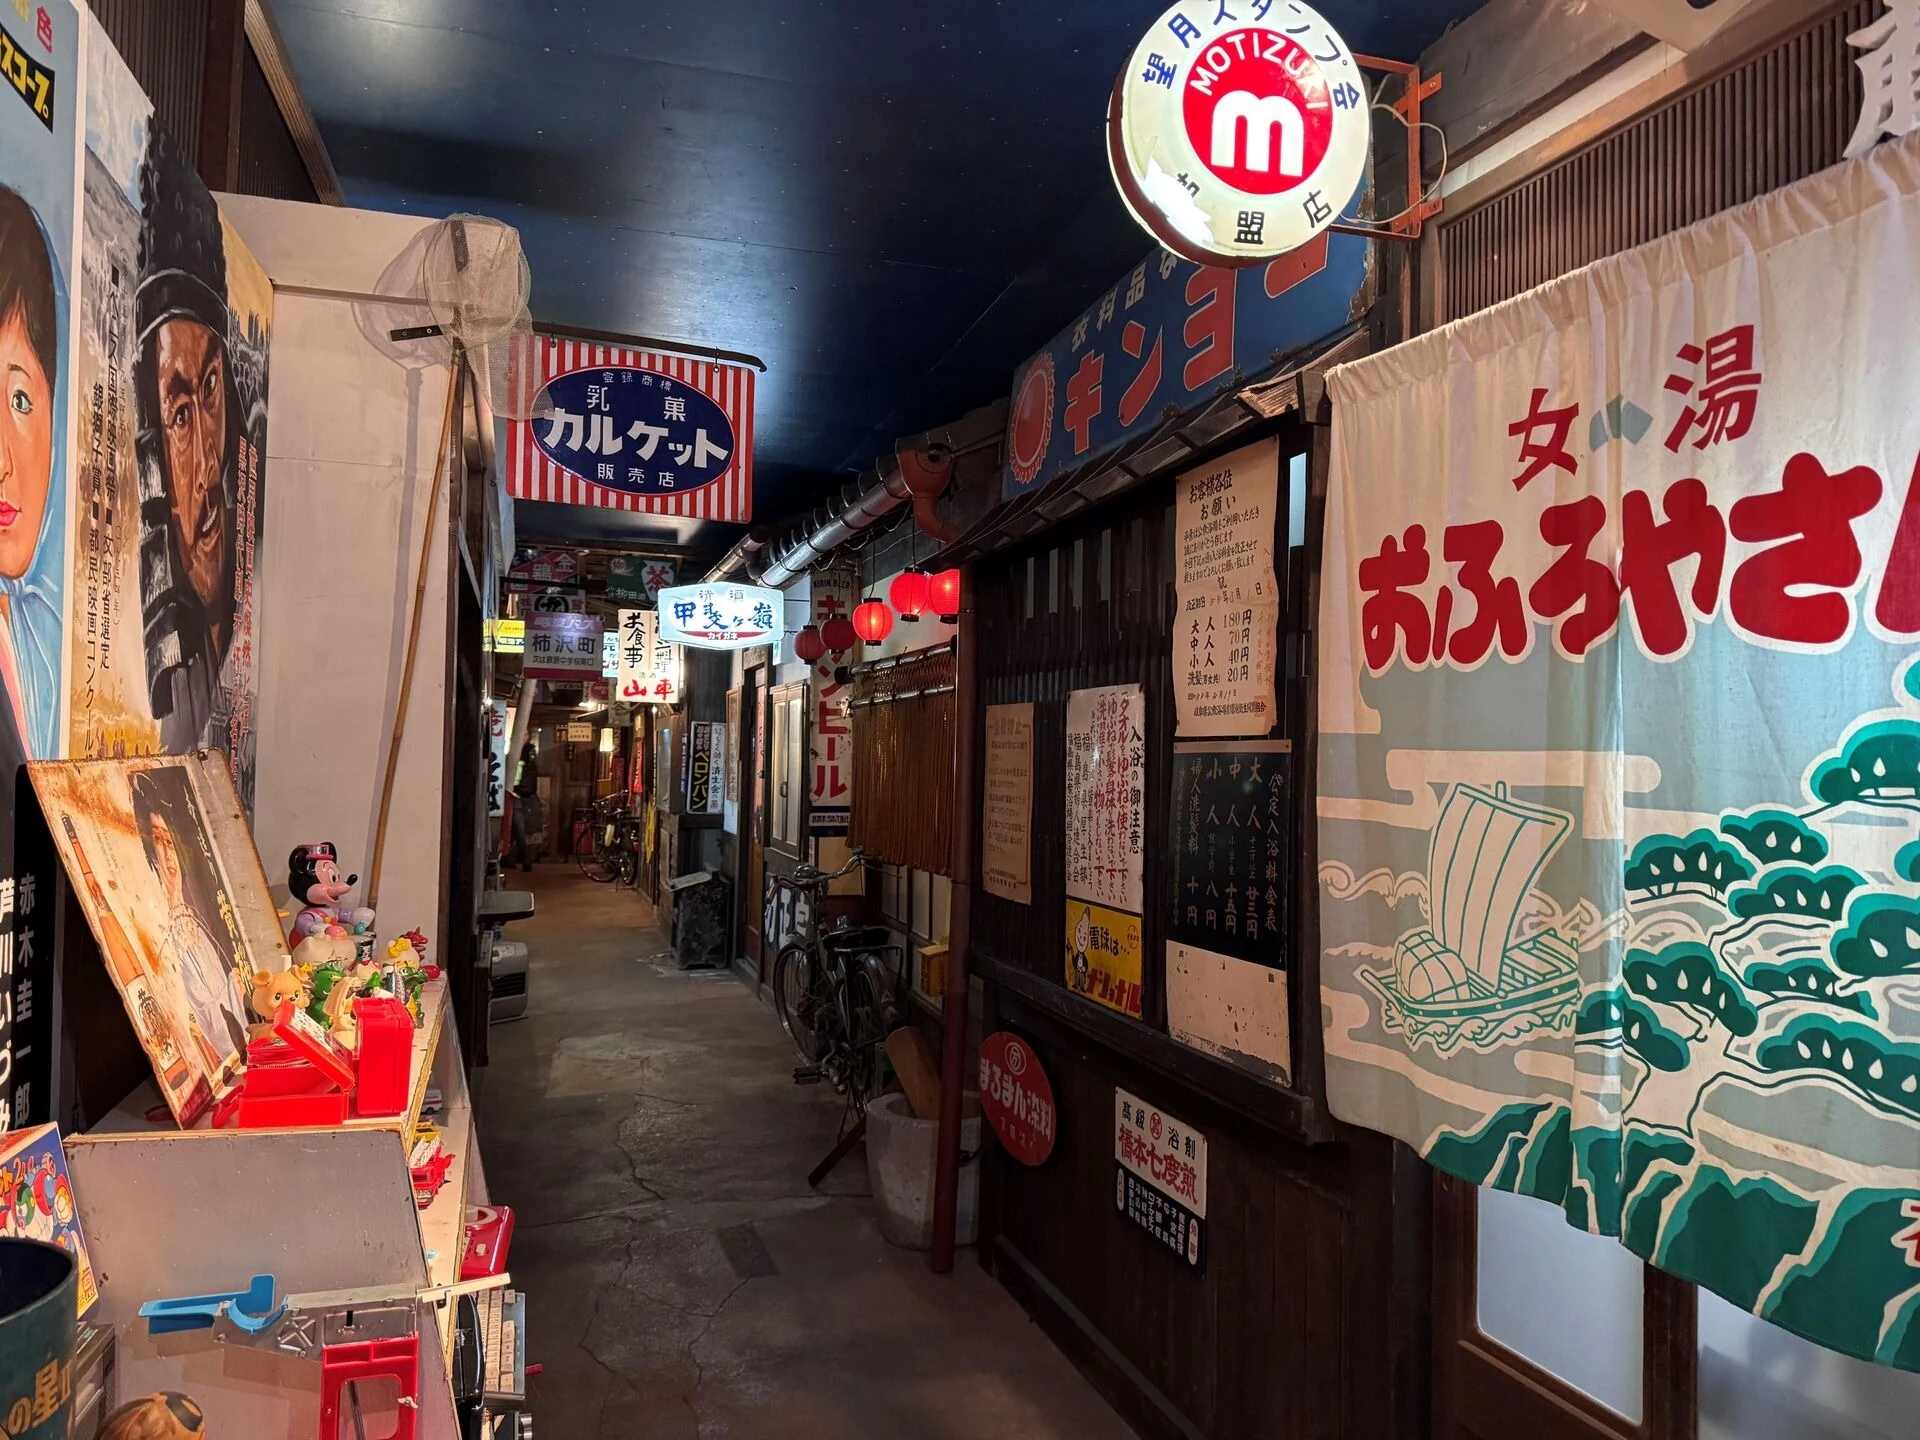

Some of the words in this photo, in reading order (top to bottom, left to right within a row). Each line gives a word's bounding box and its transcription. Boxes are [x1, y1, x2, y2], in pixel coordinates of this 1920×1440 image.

[1190, 32, 1328, 109] MOTIZUKI
[602, 371, 672, 392] 登録商標
[542, 407, 729, 468] カルケット
[597, 463, 675, 488] 販売店
[1189, 469, 1232, 504] お客様各位
[1200, 496, 1236, 520] お願い
[1359, 452, 1920, 670] おふろやさ
[532, 634, 596, 654] 柿沢町
[623, 612, 646, 668] お食事
[1190, 616, 1216, 634] 大人
[1223, 609, 1252, 628] 180円
[1190, 635, 1214, 652] 中人
[1228, 628, 1250, 645] 70円
[1189, 652, 1214, 669] 小人
[1228, 646, 1249, 664] 40円
[1227, 664, 1248, 683] 20円
[1129, 725, 1143, 855] 入浴の御注意
[1186, 876, 1199, 927] 十円
[1205, 880, 1219, 931] 八円
[1224, 880, 1238, 937] 十五円
[15, 872, 36, 1129] 赤木圭一郎
[1086, 968, 1141, 1014] ナショナル
[1122, 1101, 1145, 1130] 高級
[1168, 1126, 1196, 1160] 浴剤
